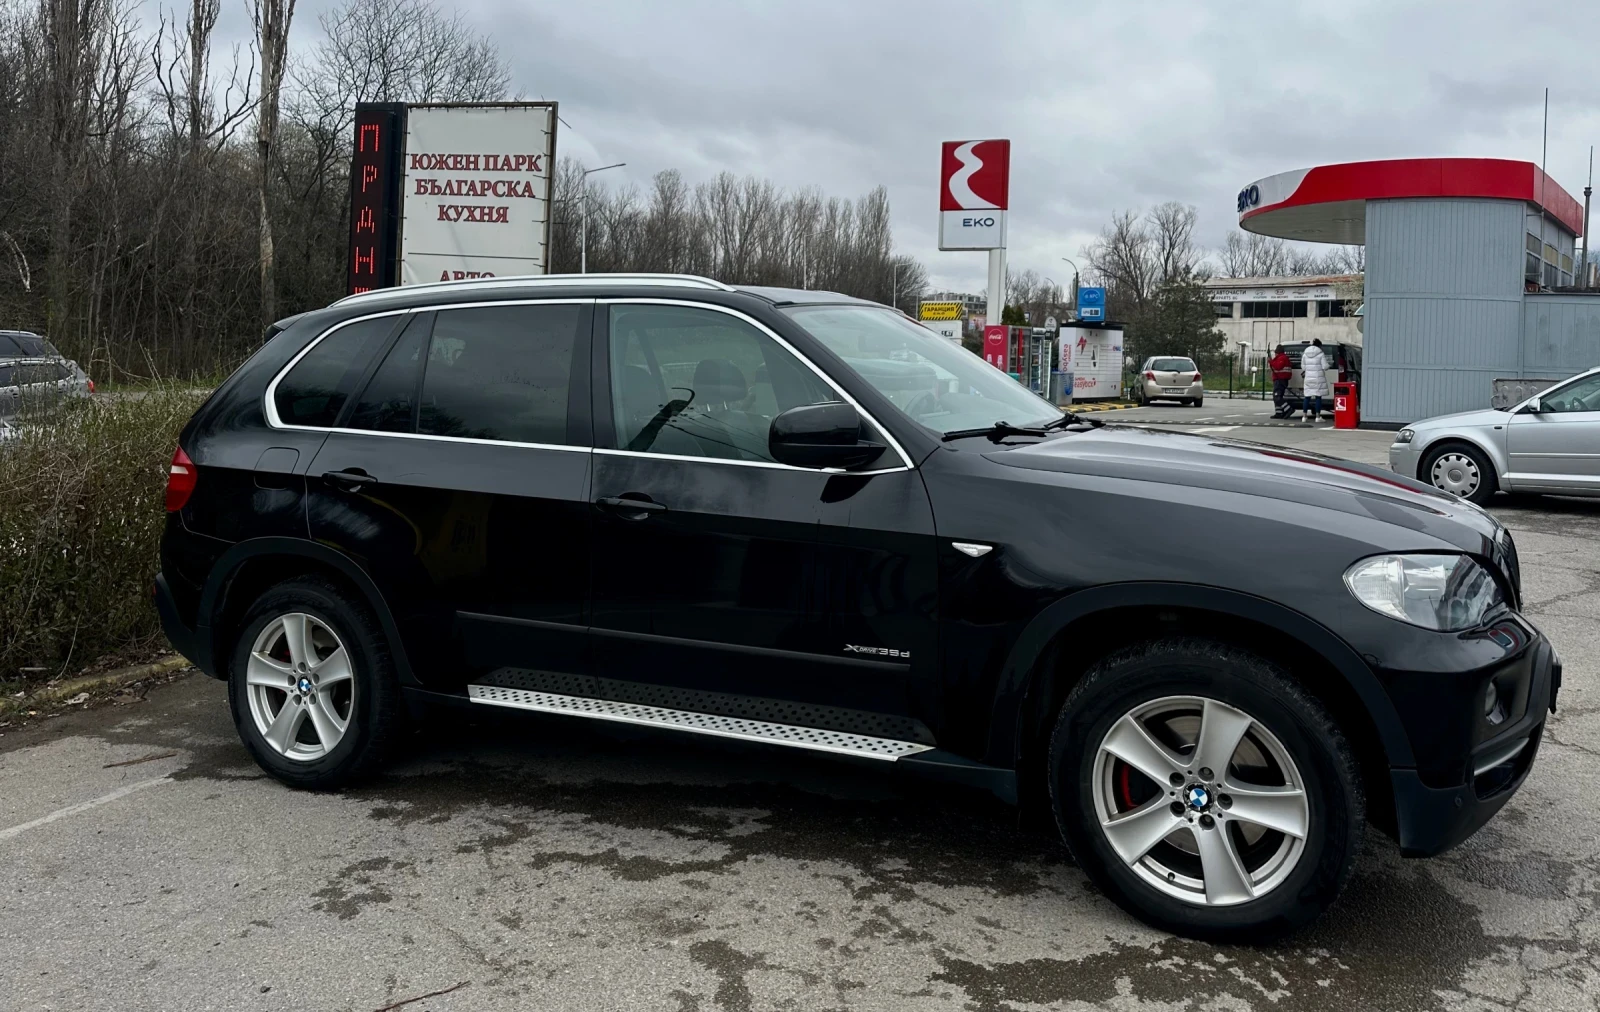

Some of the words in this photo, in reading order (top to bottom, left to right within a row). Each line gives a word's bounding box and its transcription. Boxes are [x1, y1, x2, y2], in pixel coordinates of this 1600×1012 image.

[410, 153, 481, 170] ЮЖЕН
[482, 154, 542, 172] ПАРК
[414, 179, 536, 198] БЪЛГАРСКА
[437, 204, 509, 223] КУХНЯ
[962, 217, 995, 227] EKO
